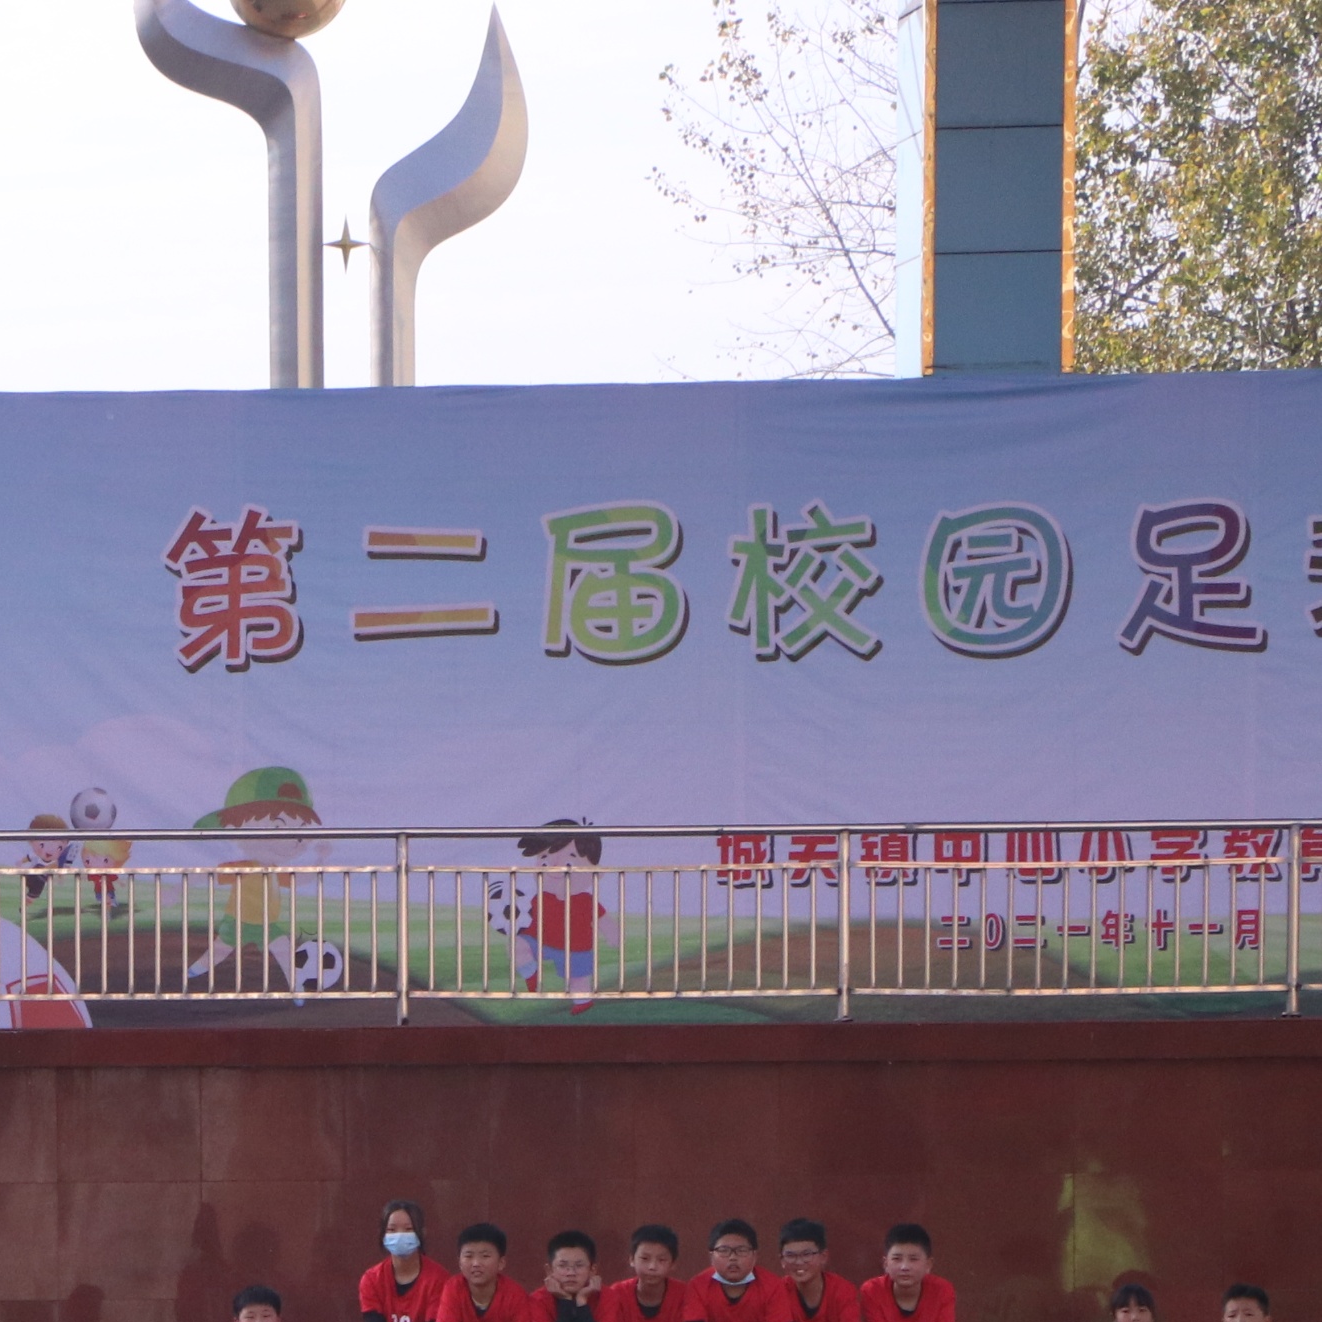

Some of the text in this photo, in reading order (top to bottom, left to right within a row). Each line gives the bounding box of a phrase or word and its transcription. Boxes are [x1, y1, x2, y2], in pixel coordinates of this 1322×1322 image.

[163, 498, 1322, 670] 第二届校园足
